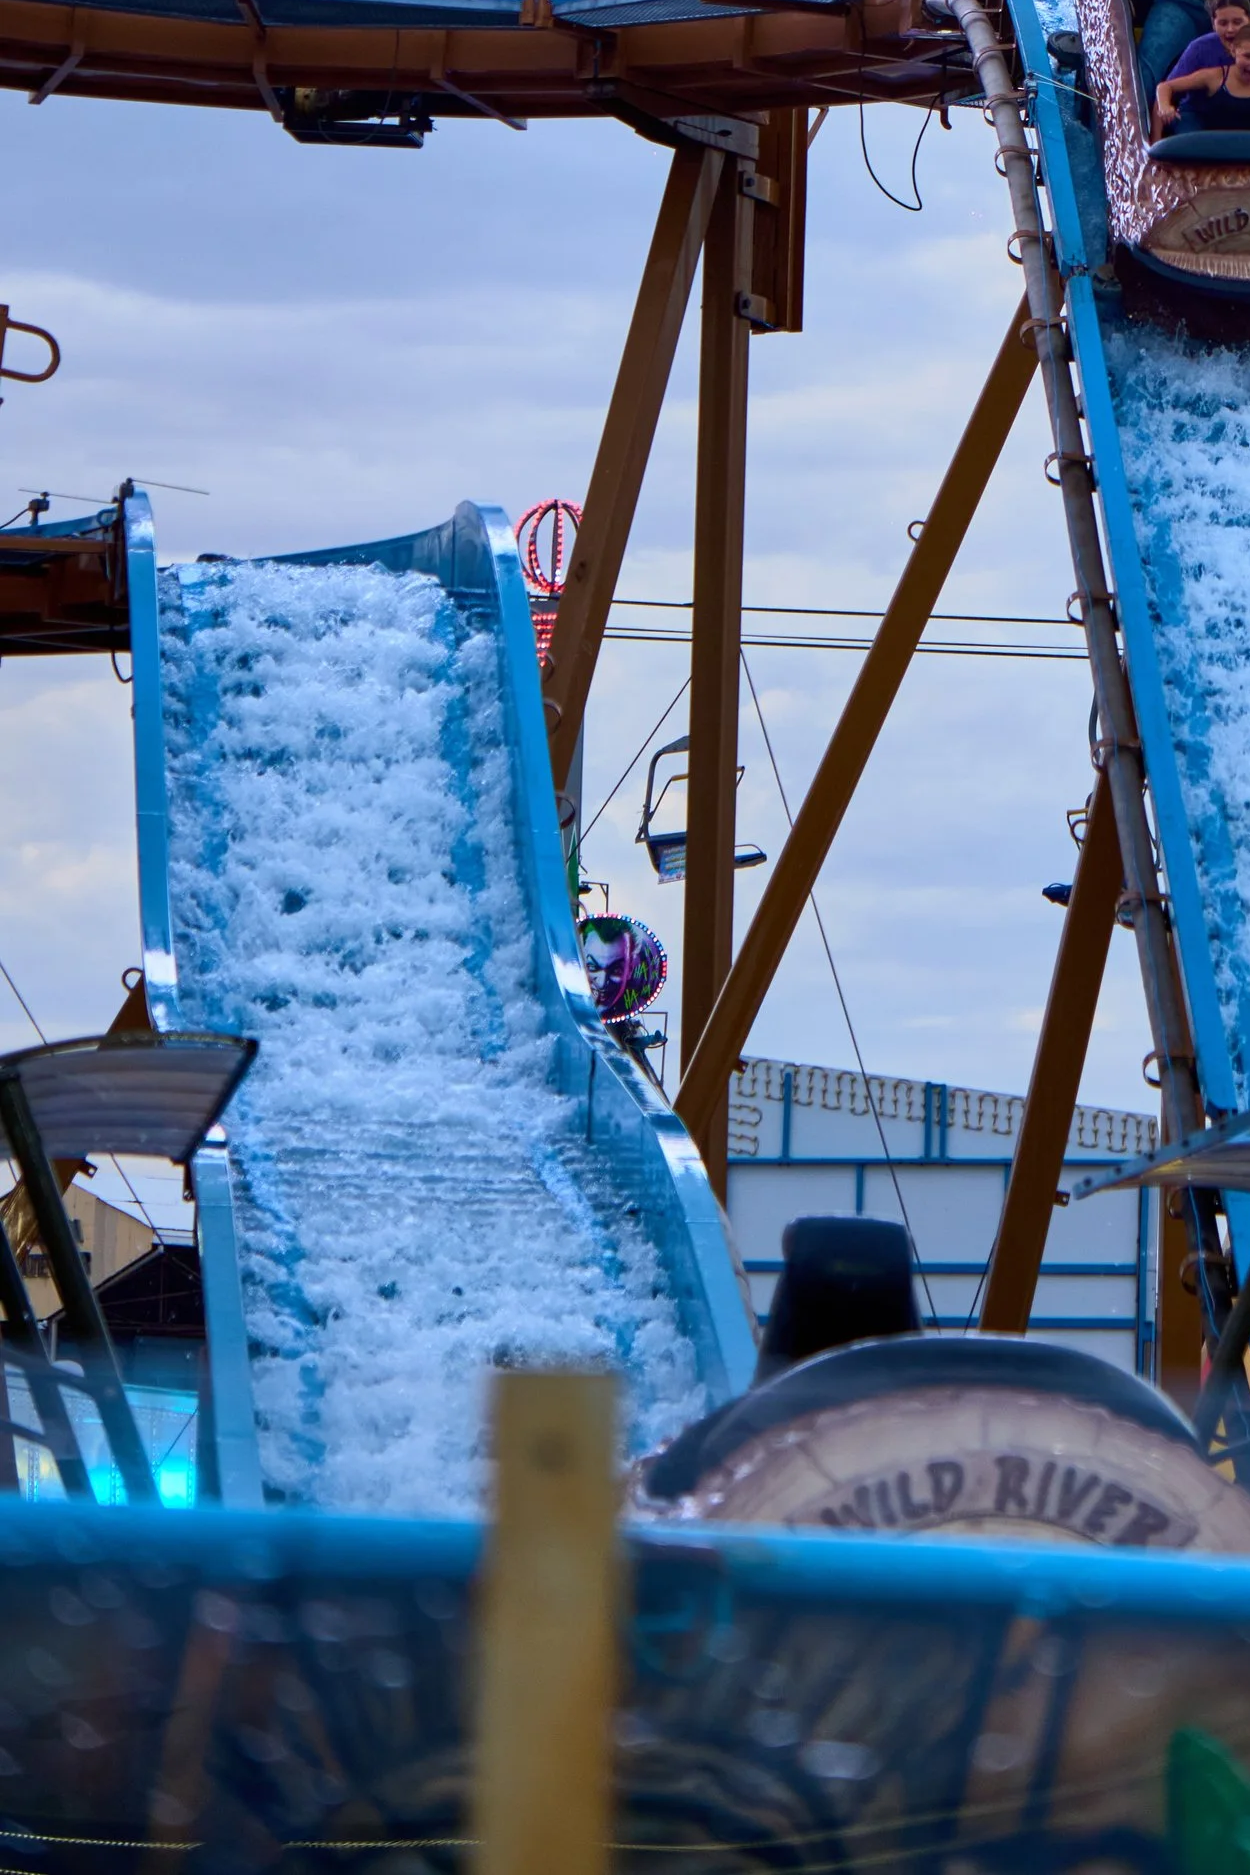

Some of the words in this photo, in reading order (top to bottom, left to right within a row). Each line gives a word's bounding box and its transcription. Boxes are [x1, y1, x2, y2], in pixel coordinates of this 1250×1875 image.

[1194, 208, 1250, 244] WILD
[819, 1460, 965, 1537] WILD
[994, 1455, 1170, 1548] RIVER
